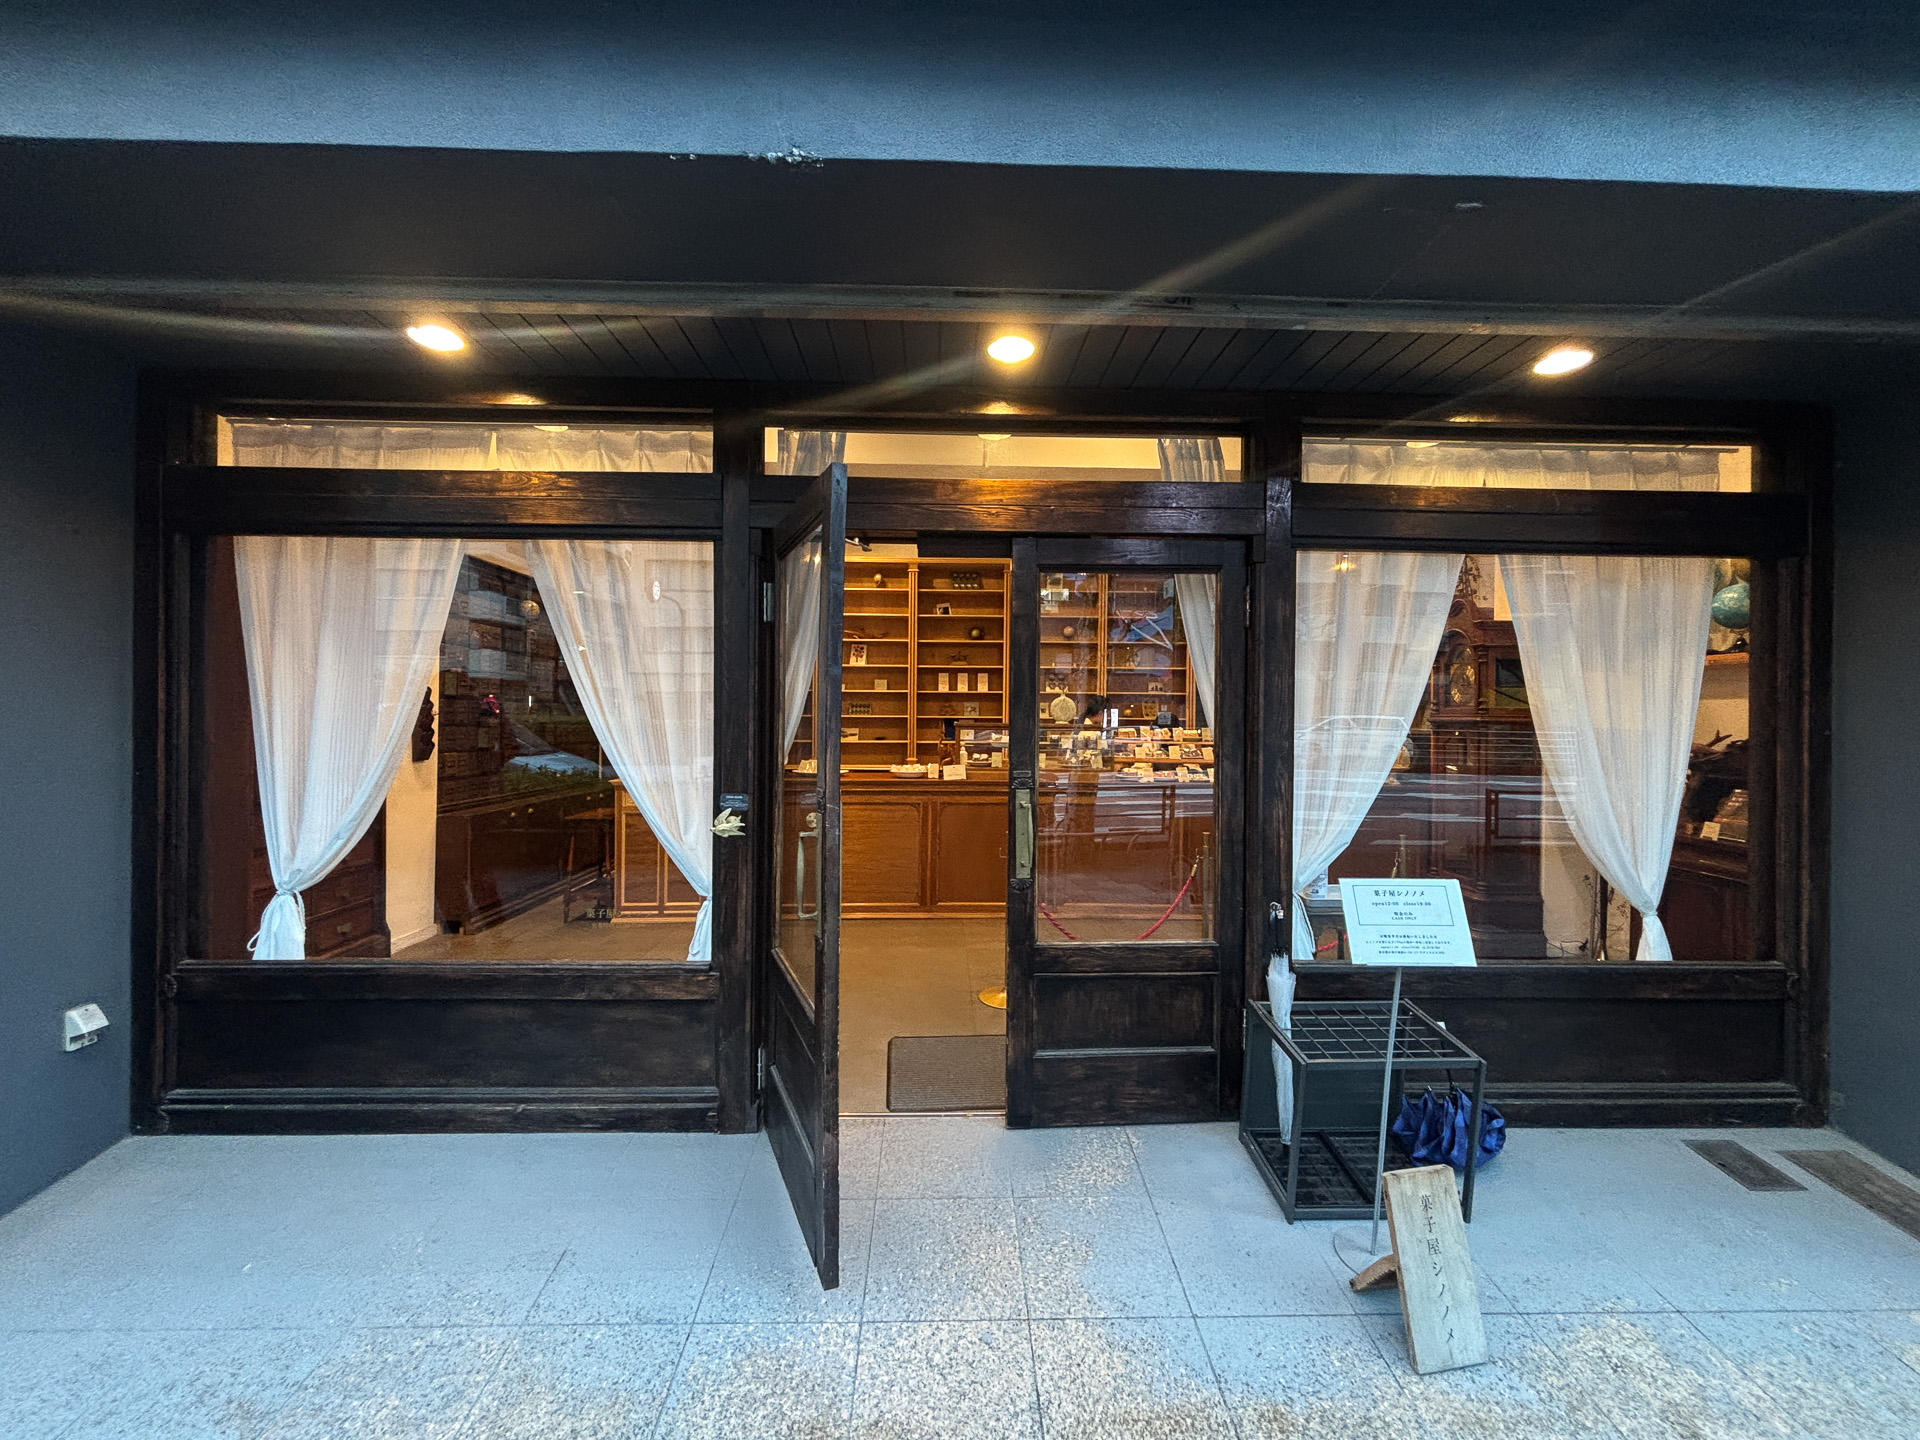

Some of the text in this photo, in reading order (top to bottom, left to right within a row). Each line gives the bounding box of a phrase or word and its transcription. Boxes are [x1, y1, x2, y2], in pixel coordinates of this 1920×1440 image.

[1374, 889, 1425, 897] 菓子屋シノノメ
[1419, 1194, 1454, 1343] 菓子屋シノノメ
